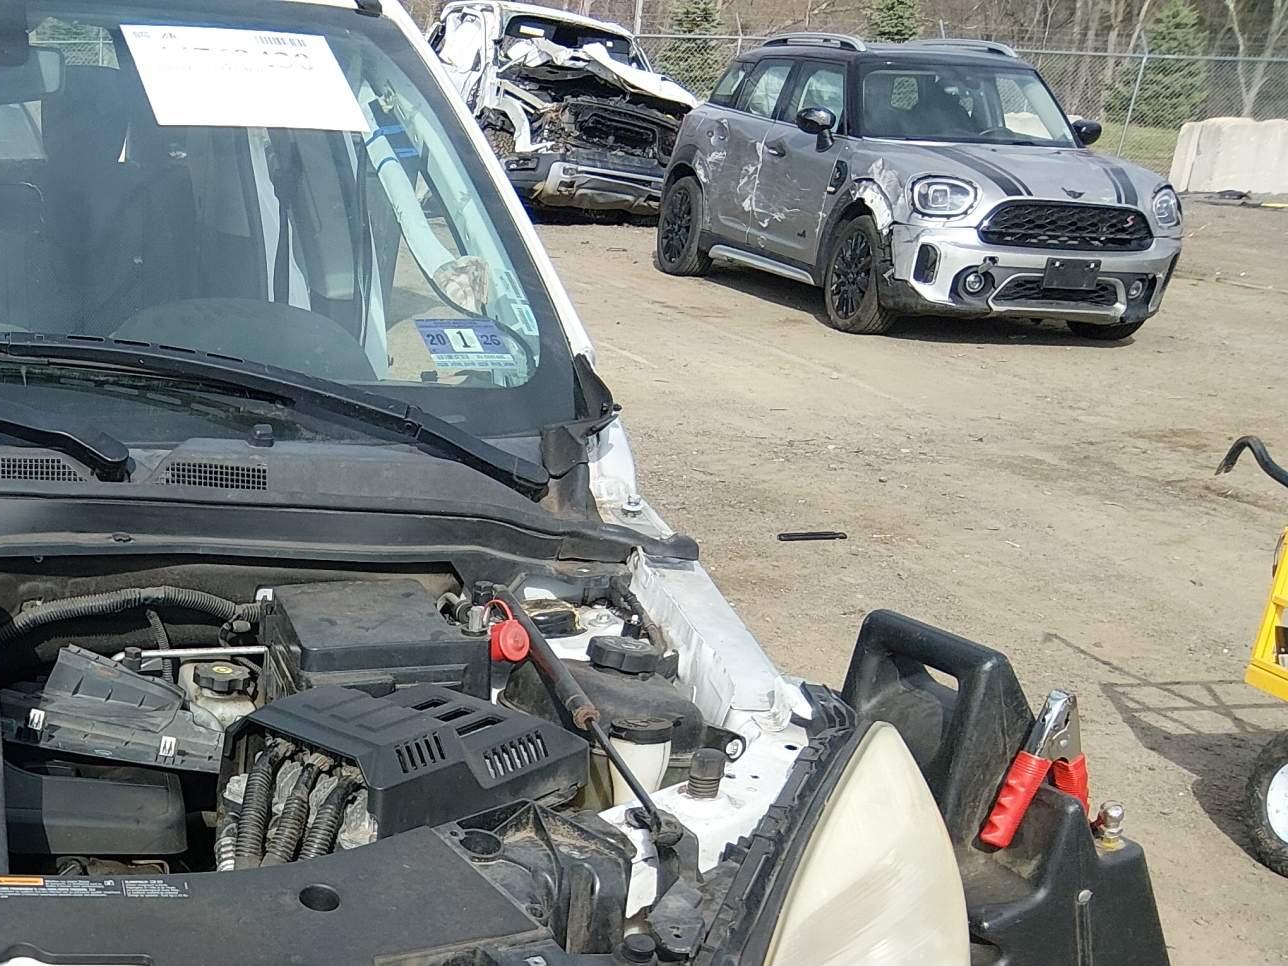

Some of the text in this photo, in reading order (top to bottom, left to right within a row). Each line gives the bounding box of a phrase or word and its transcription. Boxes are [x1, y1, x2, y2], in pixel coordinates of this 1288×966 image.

[426, 330, 501, 348] 20 1 26
